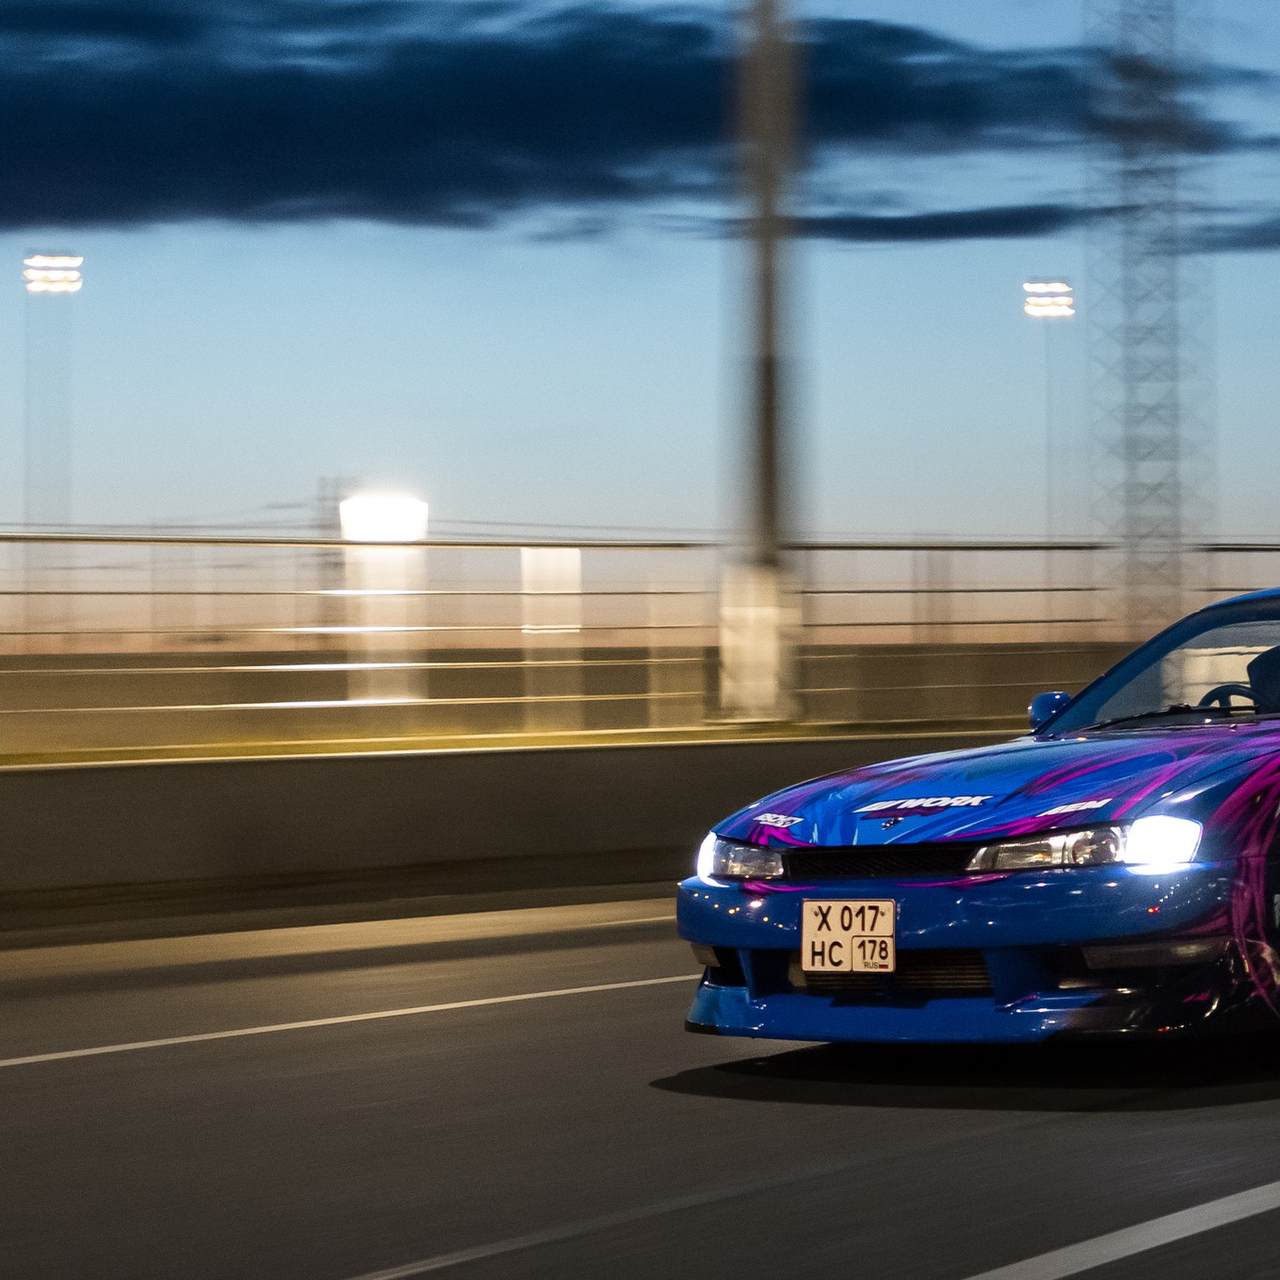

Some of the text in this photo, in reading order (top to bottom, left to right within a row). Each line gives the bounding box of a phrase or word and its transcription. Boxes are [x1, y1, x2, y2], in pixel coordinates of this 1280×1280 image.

[897, 796, 994, 809] WORK
[1035, 798, 1114, 817] AEM
[840, 905, 880, 931] 017
[857, 939, 889, 960] 178
[864, 961, 879, 969] RUS
